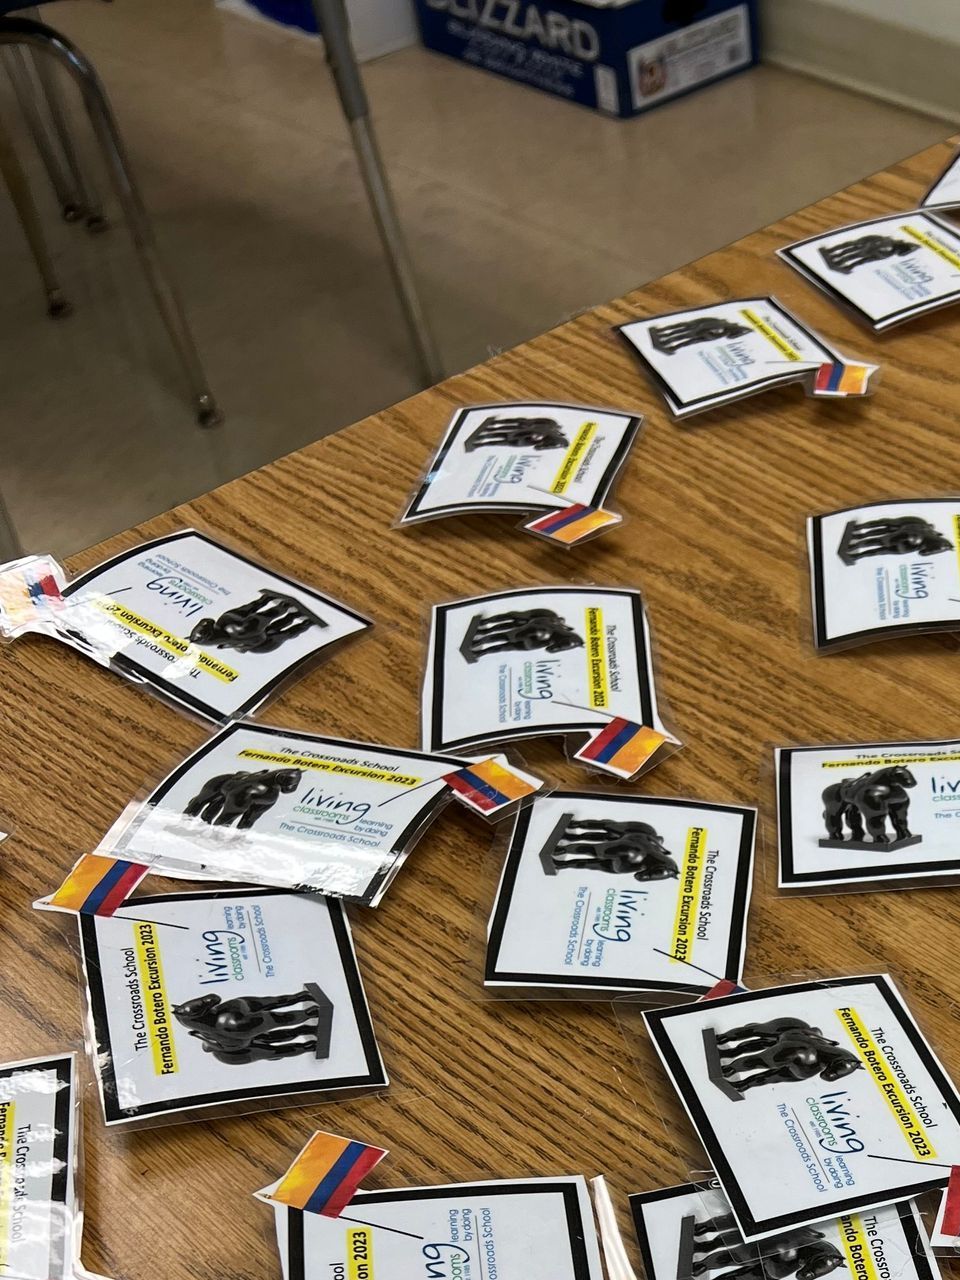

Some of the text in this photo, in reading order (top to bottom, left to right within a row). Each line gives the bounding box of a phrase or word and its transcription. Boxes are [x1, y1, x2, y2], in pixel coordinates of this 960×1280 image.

[517, 658, 561, 700] living
[278, 746, 401, 772] The Crossroads School
[298, 786, 374, 826] living
[592, 889, 649, 943] living
[673, 826, 703, 961] Fernando Botero Excursion 2023
[696, 849, 719, 941] The Crossroads School
[195, 929, 245, 985] living
[119, 947, 148, 1052] The Crossroads School
[138, 923, 175, 1075] Fernando Botero Excursion 2023
[838, 1006, 932, 1157] Fernando Botero Excursion 2023
[870, 1026, 939, 1128] The Crossroads School
[776, 1102, 828, 1191] The Crossroads School
[805, 1097, 838, 1147] classrooms
[818, 1090, 868, 1154] living
[828, 1165, 844, 1188] doing
[835, 1154, 855, 1186] learning
[448, 1208, 459, 1243] learning
[461, 1208, 472, 1233] doing
[479, 1207, 493, 1238] School
[863, 1214, 878, 1237] The
[352, 1231, 367, 1261] 2023
